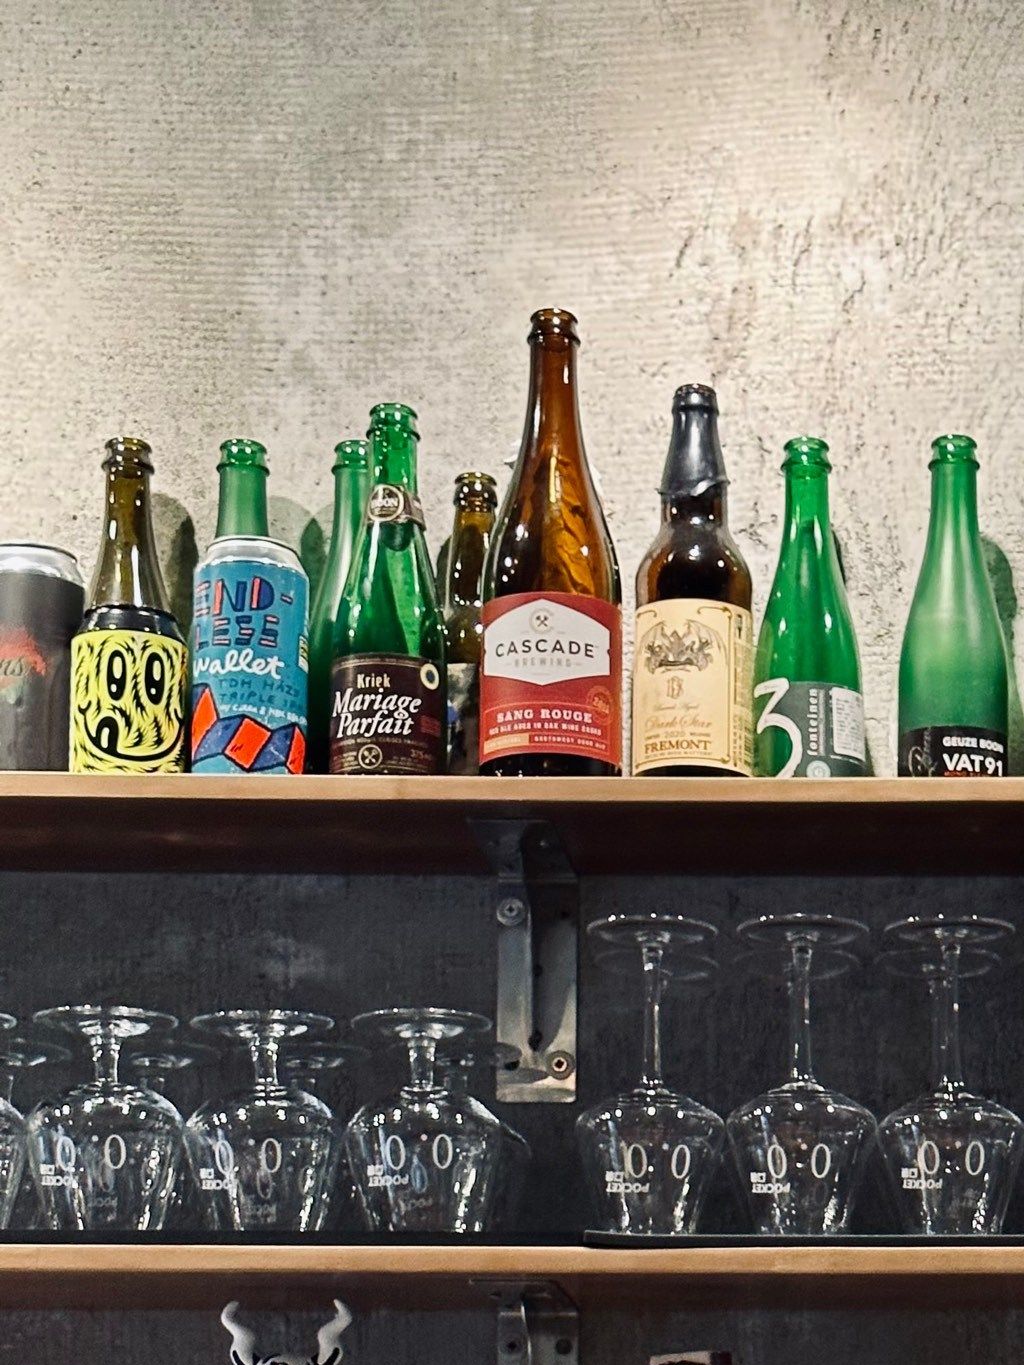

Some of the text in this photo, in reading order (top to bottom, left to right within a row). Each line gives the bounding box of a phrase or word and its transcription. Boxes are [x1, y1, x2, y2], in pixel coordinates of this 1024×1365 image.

[495, 638, 595, 658] CASCADE
[514, 657, 572, 668] BREWING
[356, 673, 391, 689] Kriek
[332, 687, 422, 720] Mariage
[496, 708, 593, 724] SANG ROUGE
[336, 709, 415, 739] Parfait
[754, 677, 802, 777] 3
[644, 739, 712, 754] FREMONT
[942, 736, 978, 748] GEUZE
[606, 1182, 650, 1194] POCKET
[752, 1182, 791, 1194] POCKET
[902, 1177, 942, 1190] POCKET
